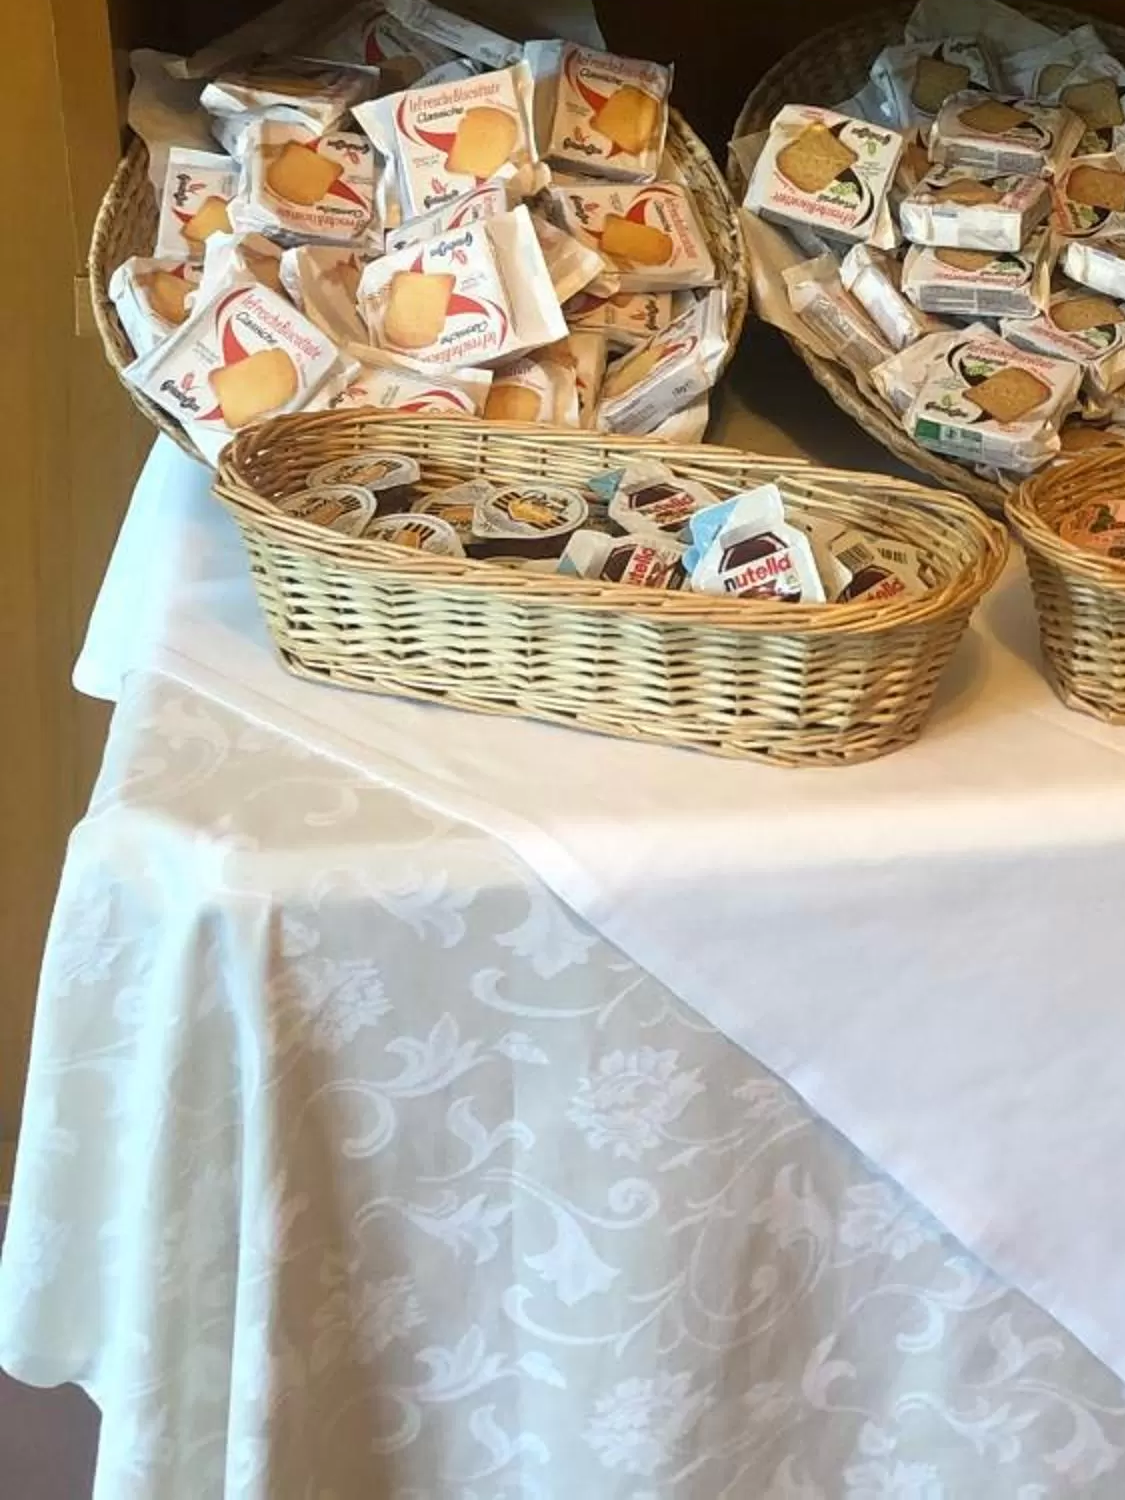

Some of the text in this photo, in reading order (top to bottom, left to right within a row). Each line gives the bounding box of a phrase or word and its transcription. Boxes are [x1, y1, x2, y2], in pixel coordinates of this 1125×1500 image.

[235, 310, 278, 344] Classiche
[723, 552, 793, 593] nutella
[866, 577, 906, 601] tella
